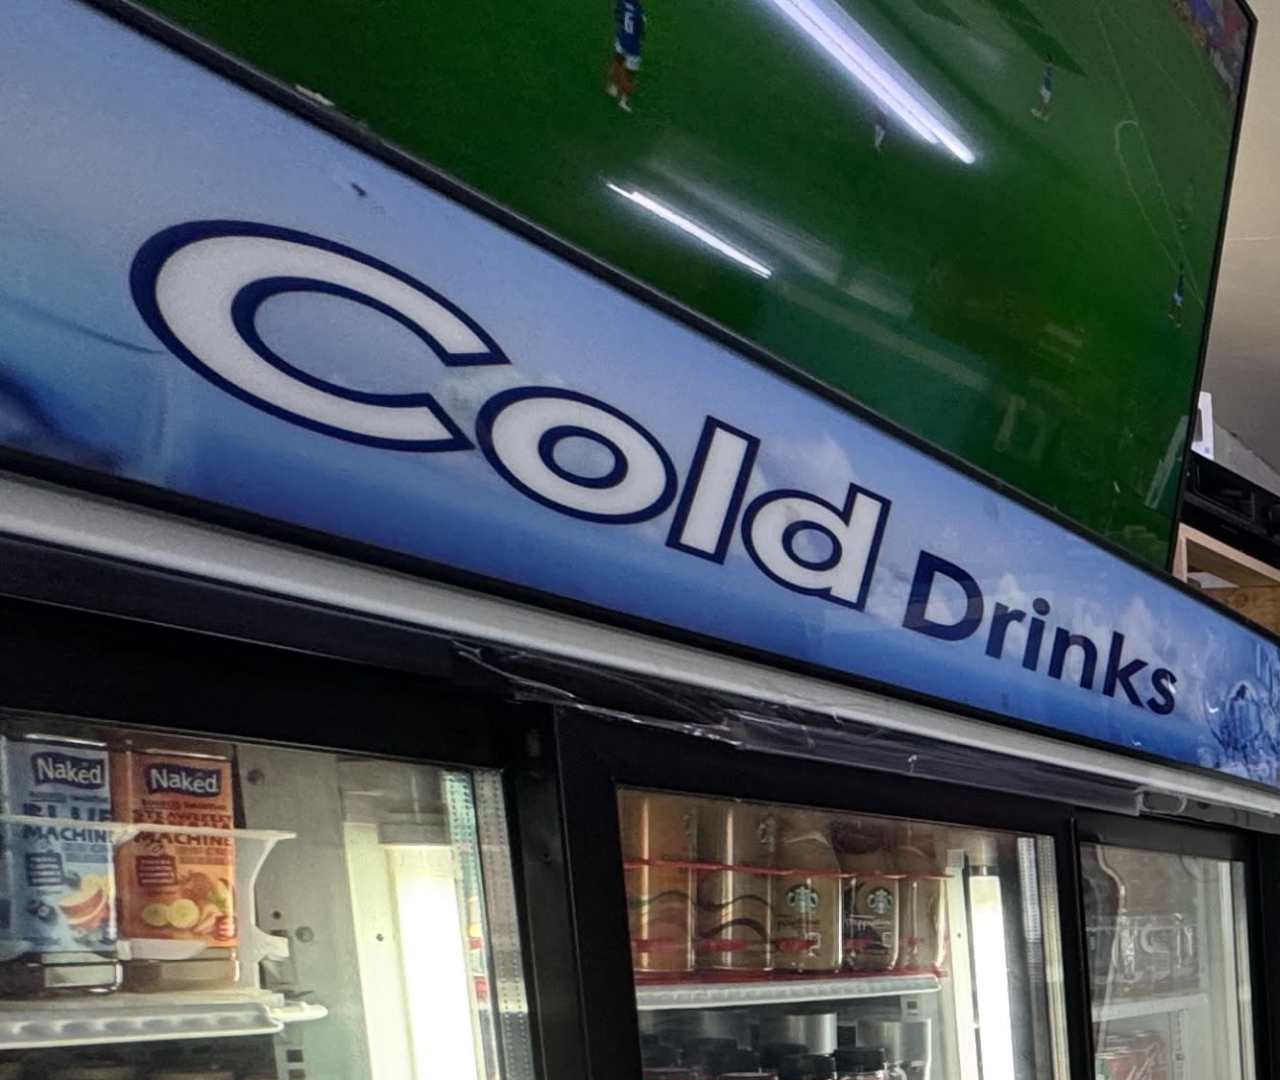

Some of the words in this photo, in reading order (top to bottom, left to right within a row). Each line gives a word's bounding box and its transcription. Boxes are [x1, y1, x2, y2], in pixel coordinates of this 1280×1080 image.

[129, 218, 888, 611] Cold
[903, 552, 1179, 716] Drinks
[37, 757, 101, 785] Naked
[151, 768, 218, 792] Naked
[22, 826, 112, 842] MACHIN
